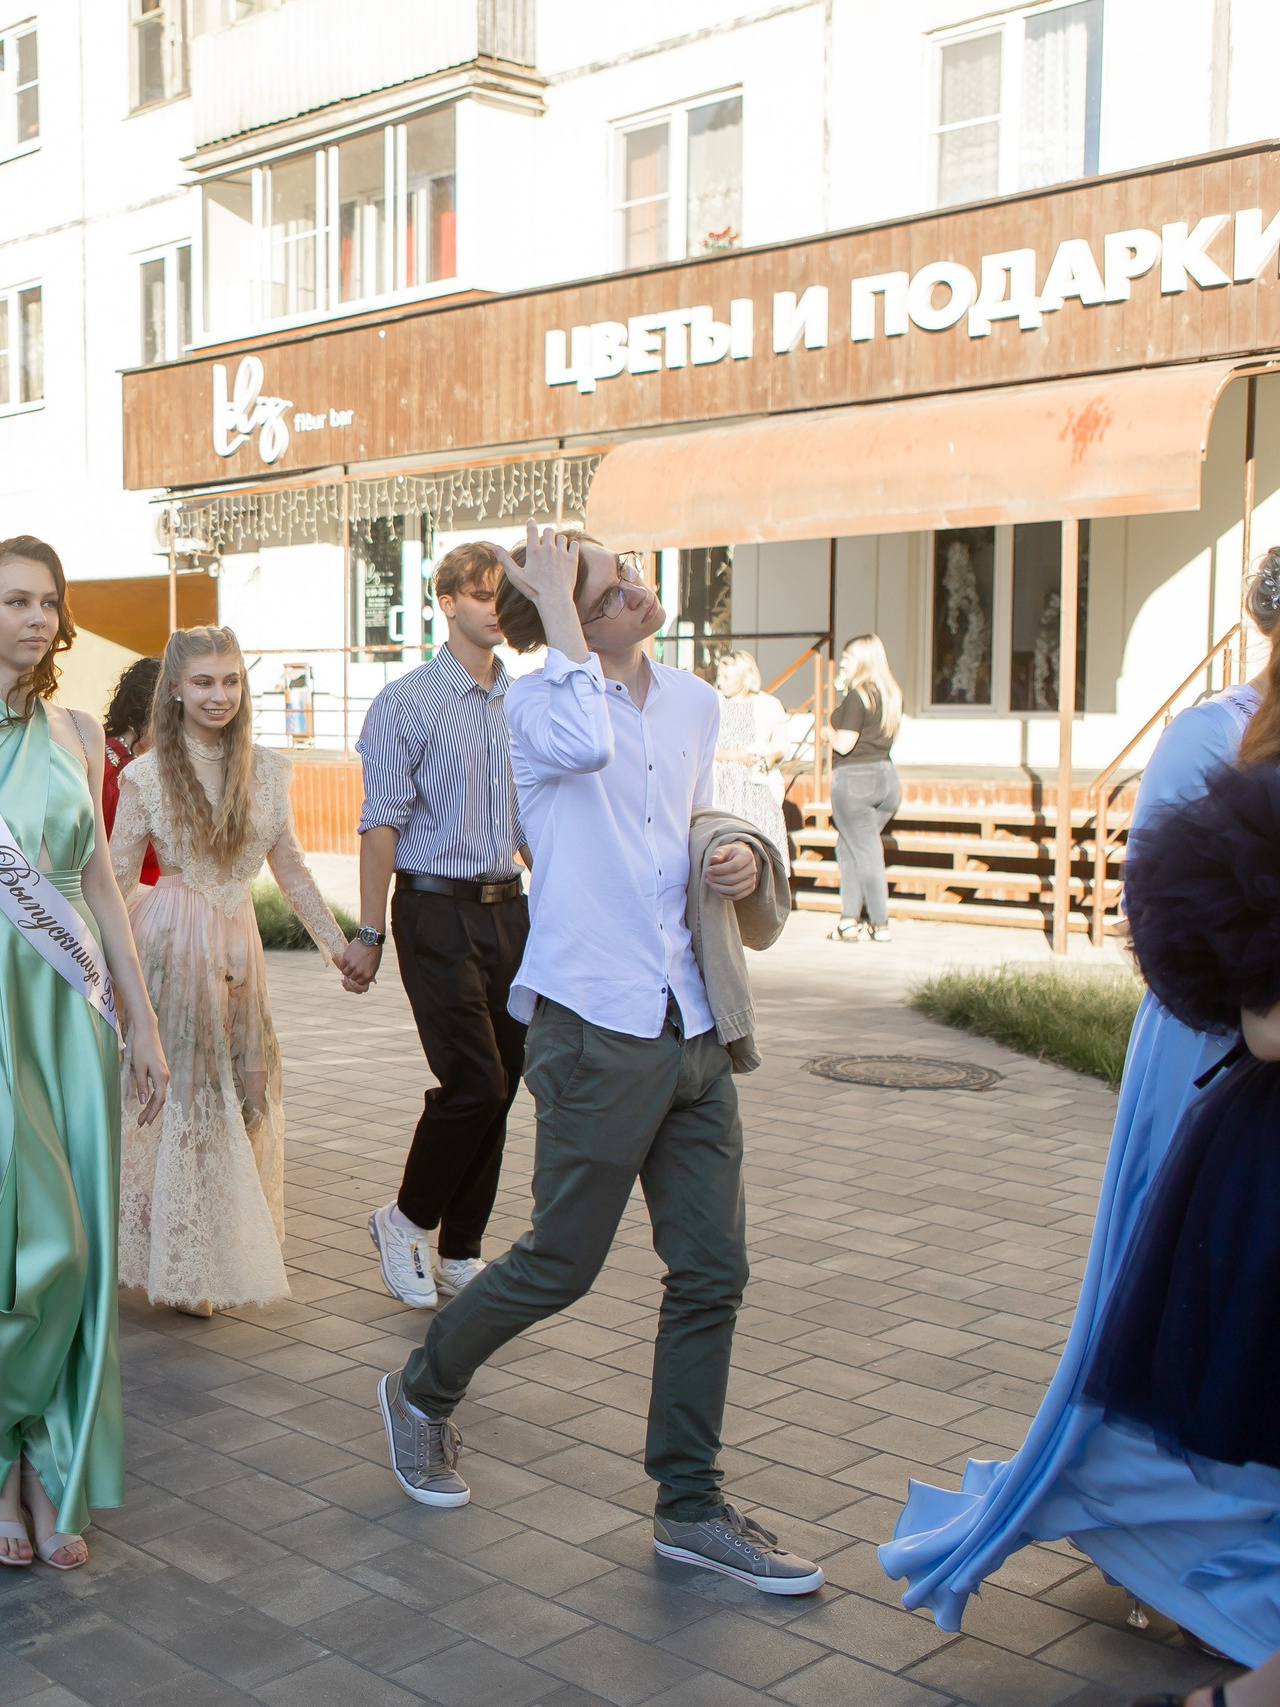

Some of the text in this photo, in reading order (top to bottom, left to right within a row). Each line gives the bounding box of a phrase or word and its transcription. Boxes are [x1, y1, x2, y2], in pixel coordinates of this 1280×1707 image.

[545, 207, 1280, 393] ЦВЕТЫ И ПОДАРКИ
[329, 408, 355, 428] bar
